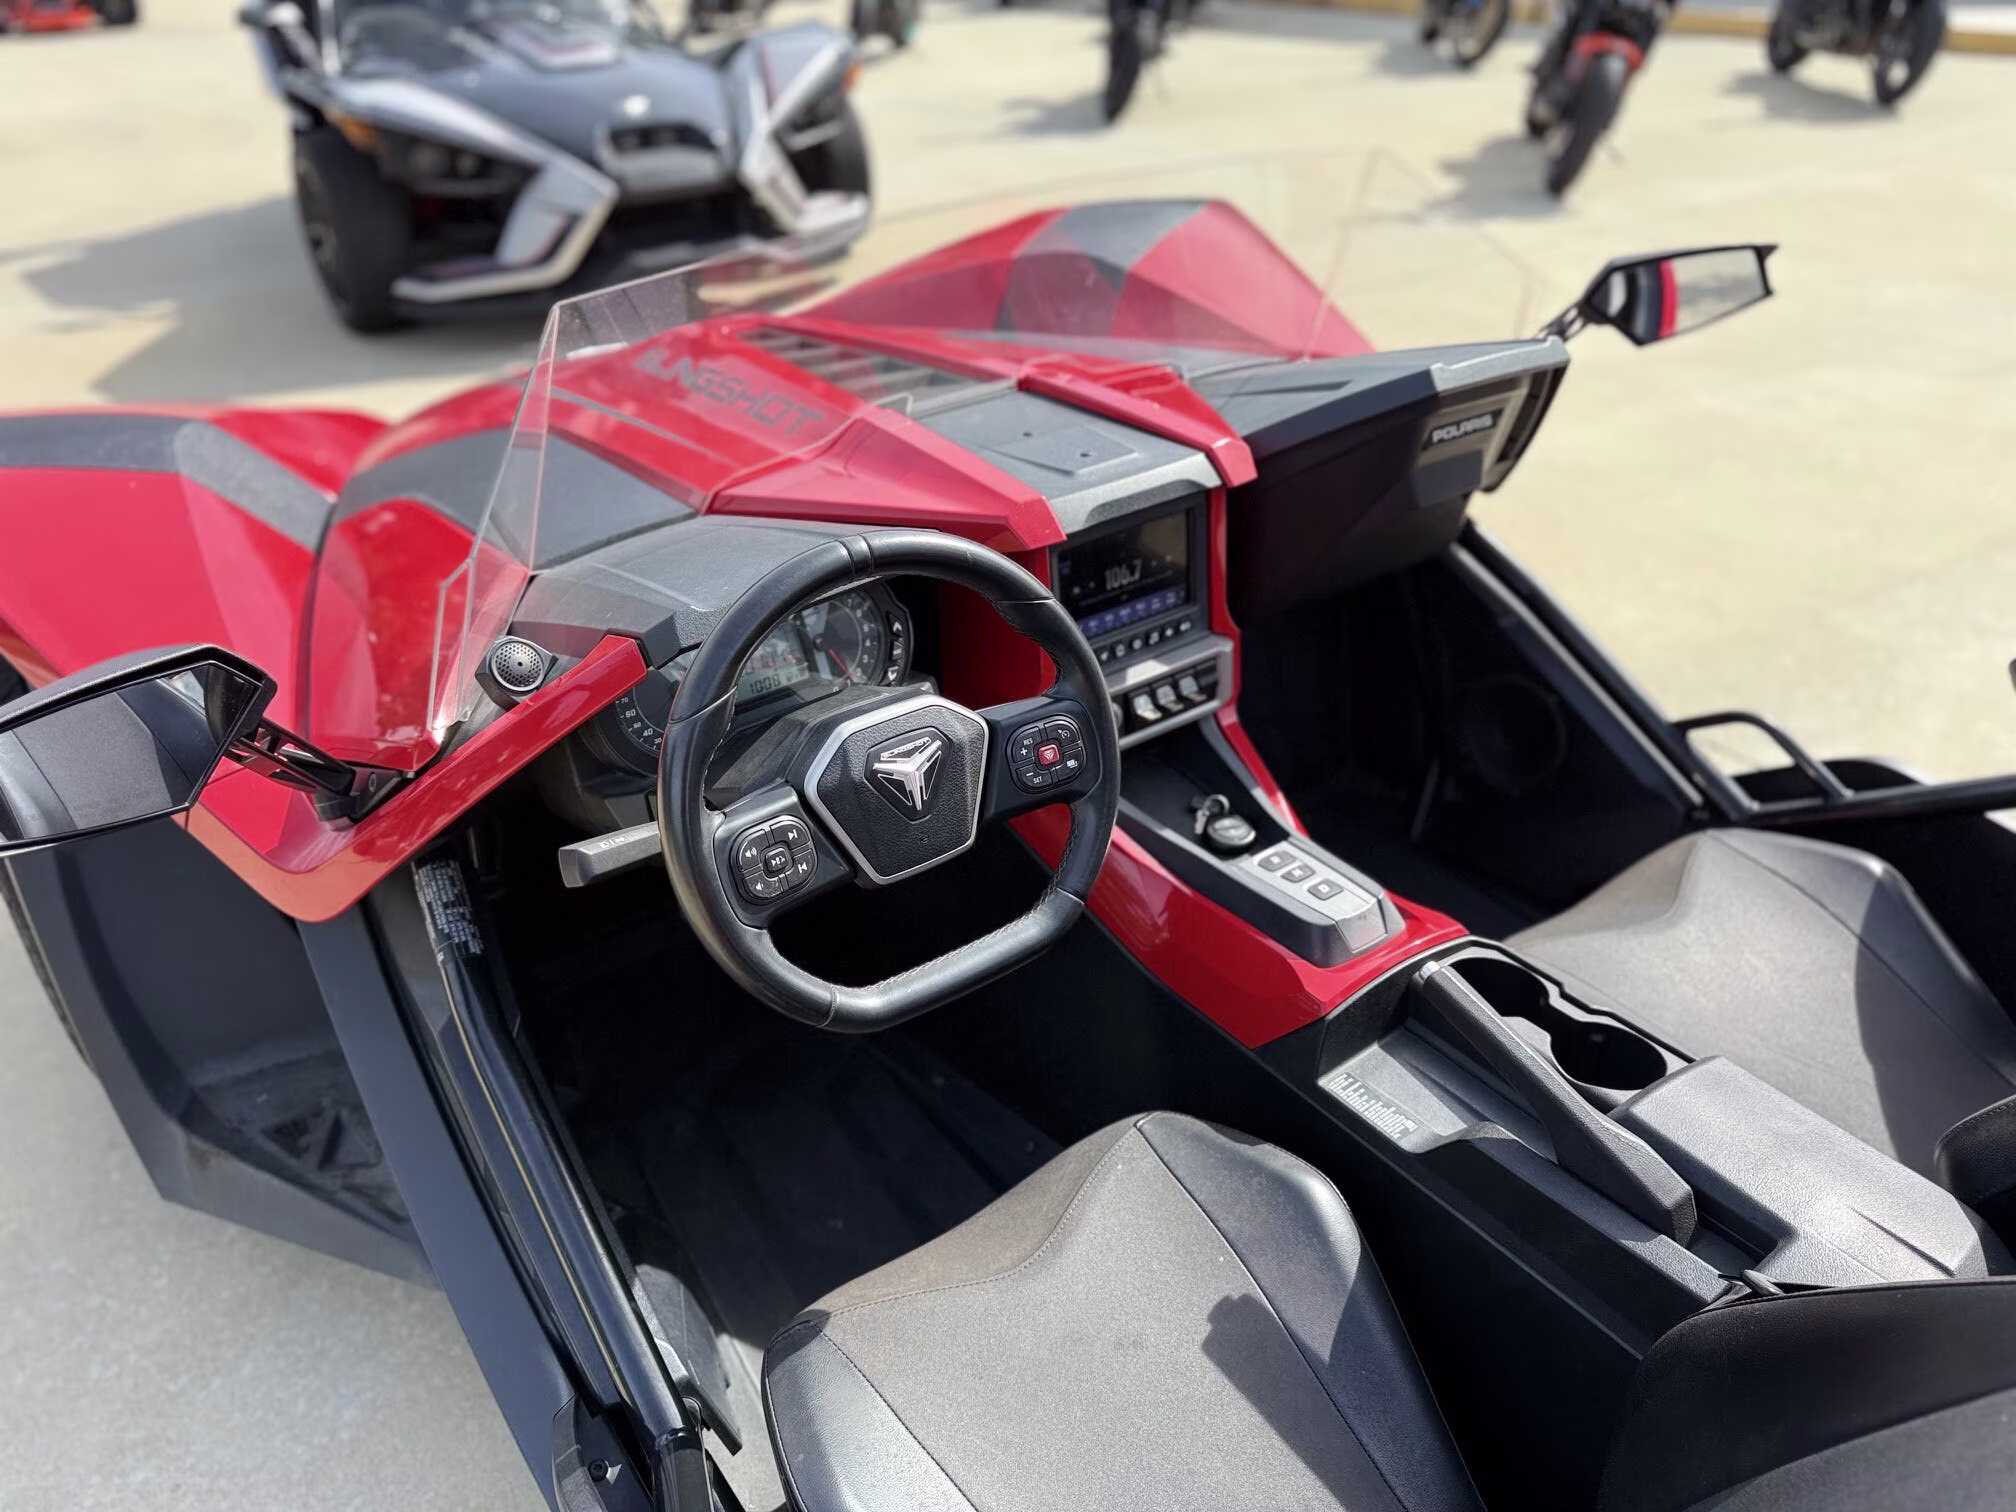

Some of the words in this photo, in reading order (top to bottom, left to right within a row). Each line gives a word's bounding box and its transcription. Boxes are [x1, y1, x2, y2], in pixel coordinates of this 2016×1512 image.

[1432, 413, 1493, 443] POLARIS
[1105, 558, 1142, 590] 106.7
[642, 728, 653, 737] 40
[1033, 776, 1043, 784] SET
